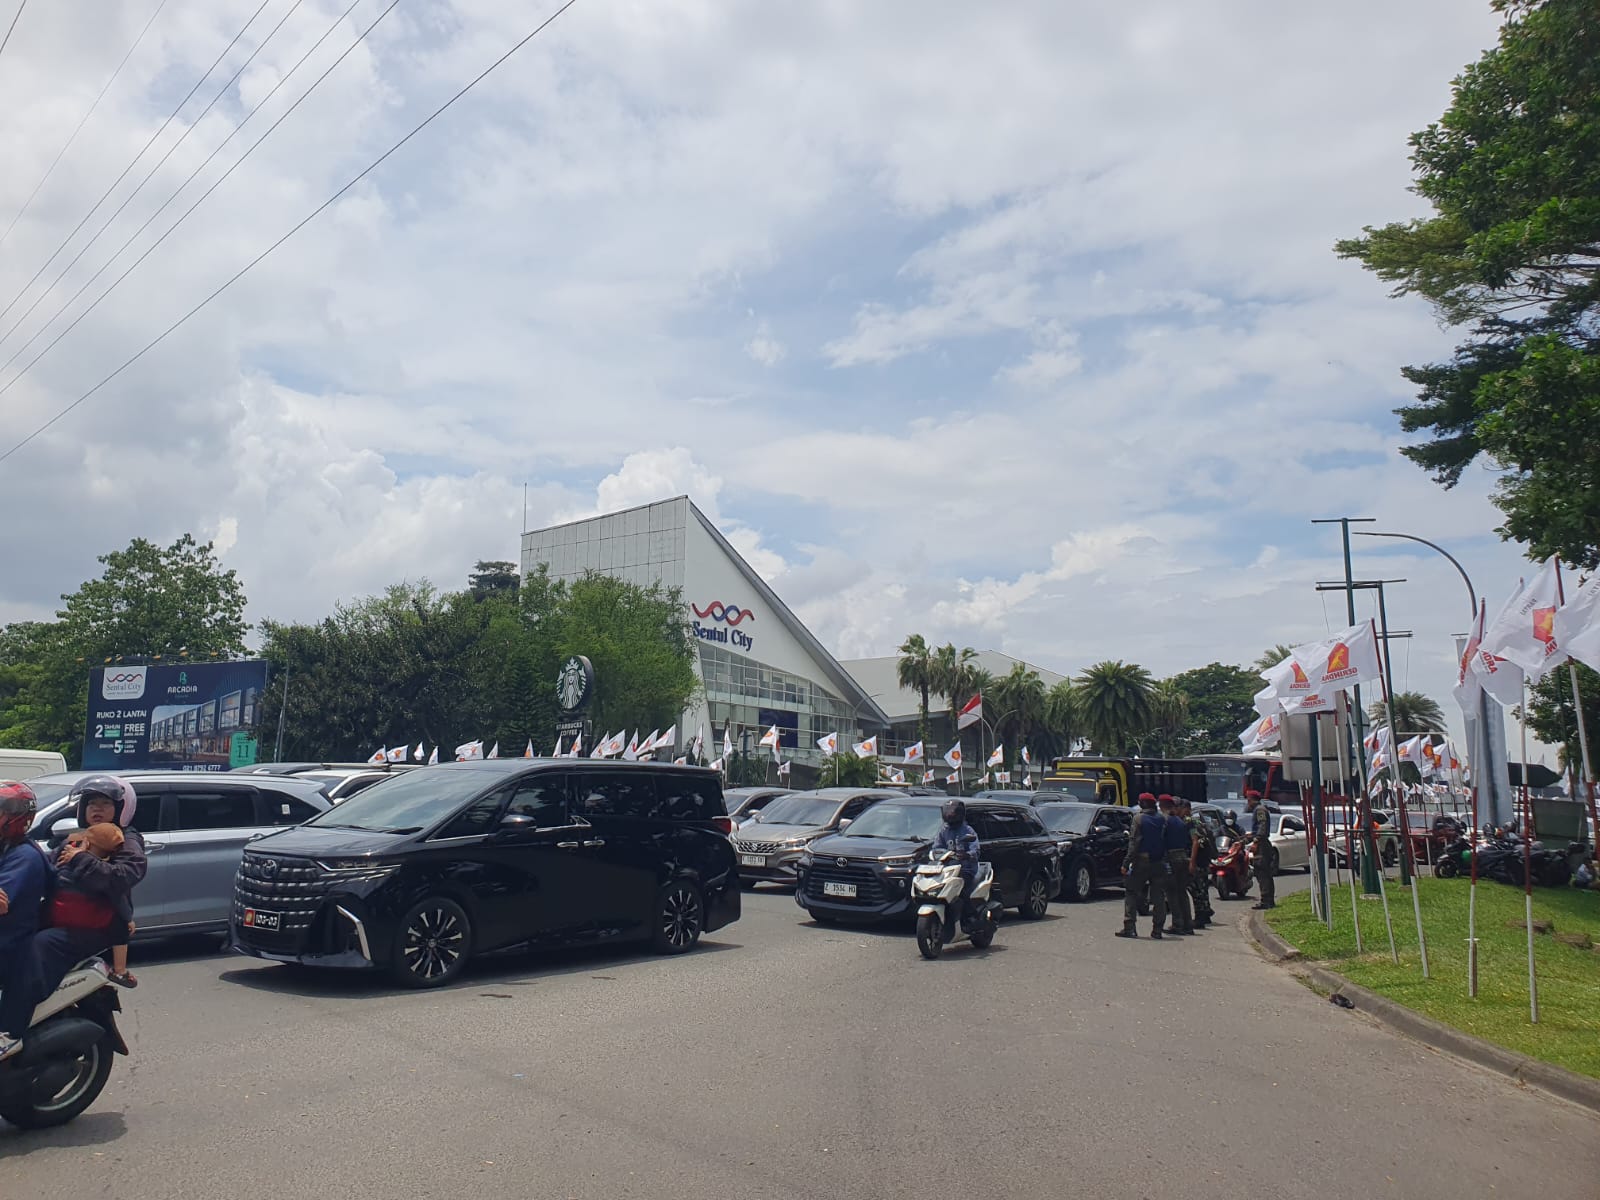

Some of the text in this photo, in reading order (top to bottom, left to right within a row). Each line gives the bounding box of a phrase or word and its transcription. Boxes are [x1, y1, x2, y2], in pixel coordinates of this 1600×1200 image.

[692, 621, 754, 651] Sentul City
[167, 685, 198, 694] ARCADIA
[96, 709, 147, 719] RUKO 2 LANTAI
[94, 724, 104, 738] 2
[124, 723, 145, 733] FREE
[556, 721, 583, 731] STARBUCKS
